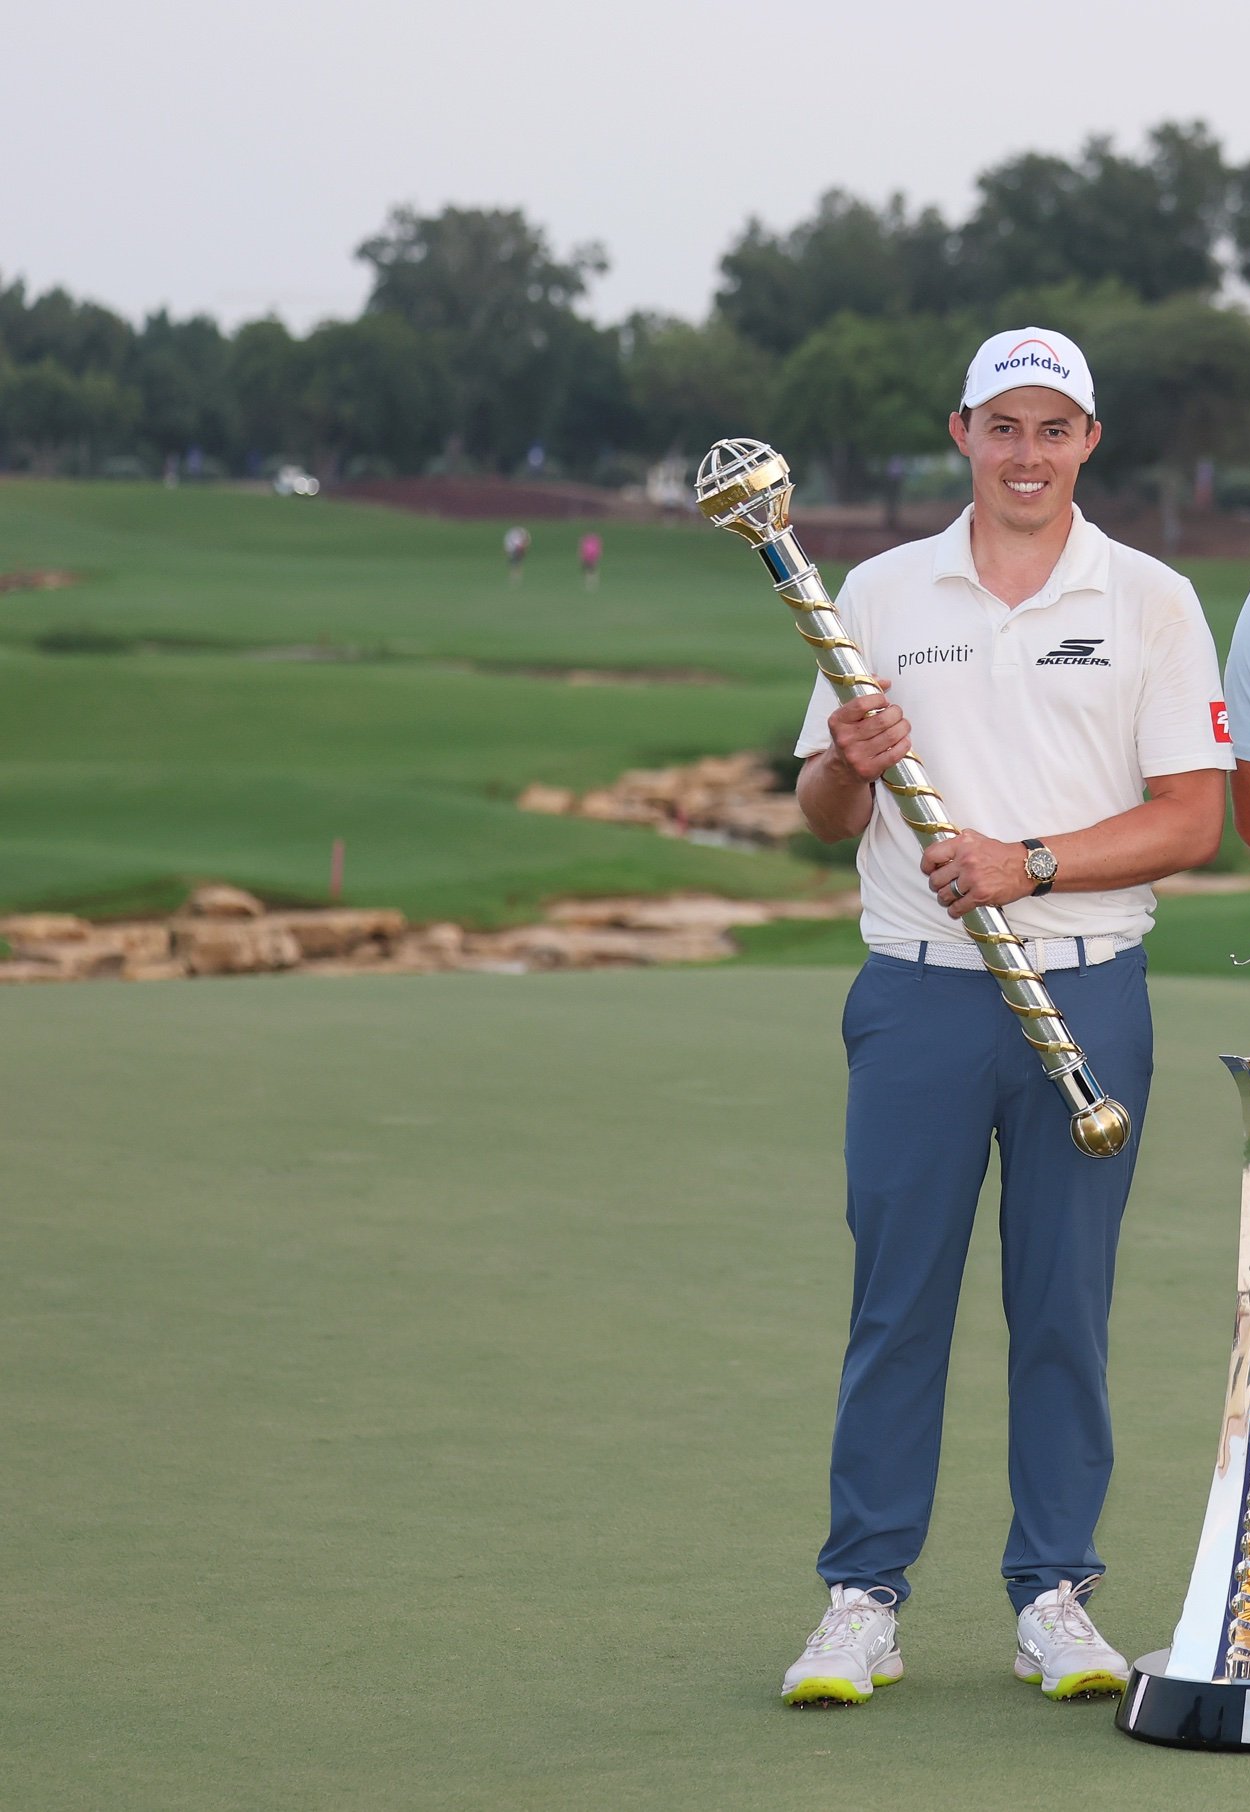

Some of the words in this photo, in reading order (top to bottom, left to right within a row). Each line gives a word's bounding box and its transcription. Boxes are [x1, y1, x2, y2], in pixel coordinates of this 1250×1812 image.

[994, 352, 1071, 380] workday
[897, 643, 969, 676] protiviti
[1035, 656, 1111, 668] SKECHERS
